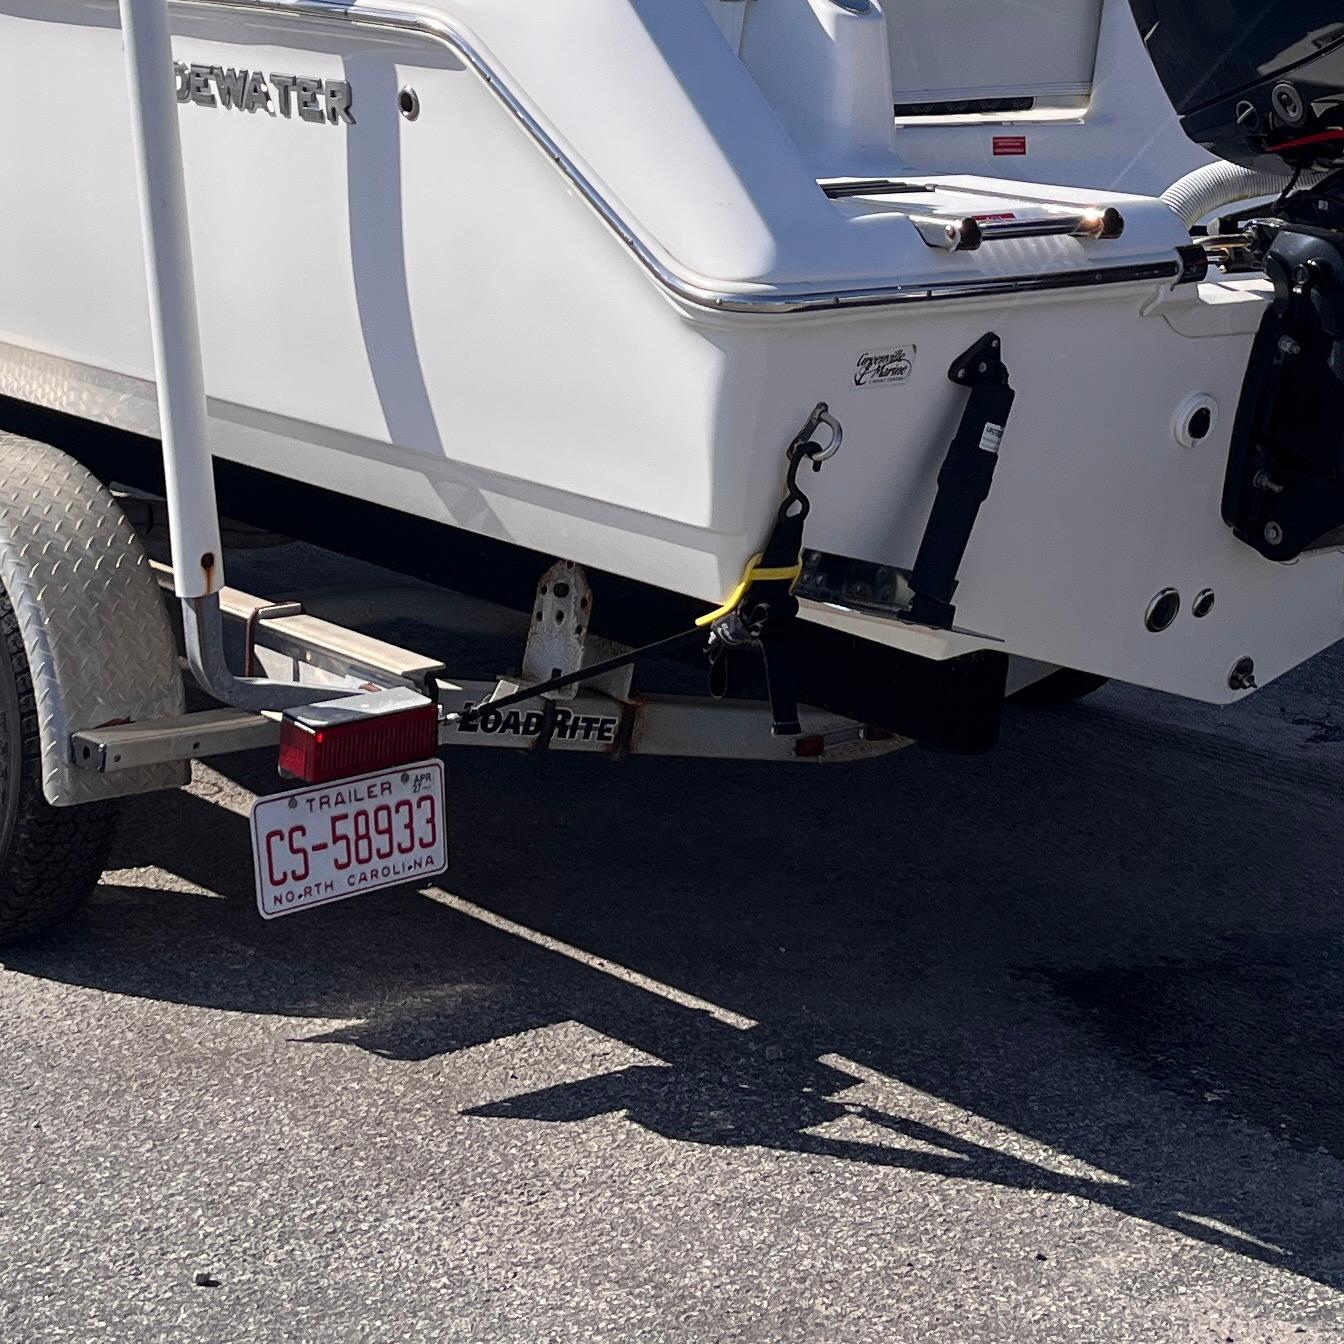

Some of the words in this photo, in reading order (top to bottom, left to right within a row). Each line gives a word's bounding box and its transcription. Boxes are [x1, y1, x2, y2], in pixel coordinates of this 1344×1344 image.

[172, 61, 357, 126] DEWATER
[305, 780, 393, 813] TRAILER
[265, 793, 438, 887] CS-58933
[273, 880, 335, 906] NORTH
[346, 854, 436, 887] CAROLINA
